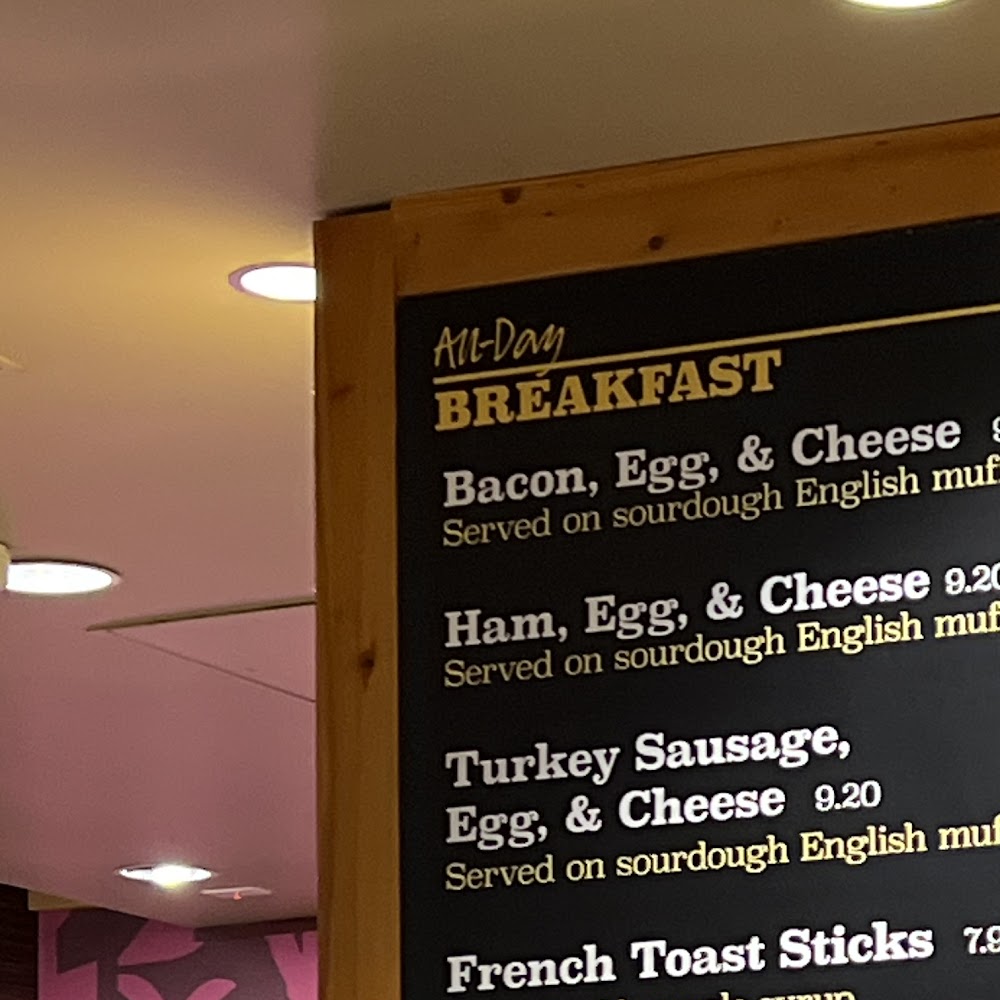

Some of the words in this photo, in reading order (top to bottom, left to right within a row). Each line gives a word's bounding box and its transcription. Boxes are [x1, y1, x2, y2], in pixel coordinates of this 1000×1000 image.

[433, 317, 565, 377] All-Day
[434, 350, 782, 432] BREAKFAST
[443, 467, 598, 507] Bacon,
[615, 449, 718, 494] Egg,
[737, 435, 774, 473] &
[792, 420, 961, 466] Cheese
[443, 508, 551, 546] Served
[563, 511, 601, 533] on
[613, 482, 784, 527] sourdough
[795, 465, 921, 509] English
[444, 609, 567, 647] Ham,
[584, 595, 688, 639] Egg,
[706, 582, 743, 620] &
[760, 570, 931, 614] Cheese
[445, 650, 553, 687] Served
[565, 653, 603, 675] on
[615, 625, 787, 670] sourdough
[796, 611, 924, 655] English
[445, 742, 621, 787] Turkey
[635, 726, 850, 771] Sausage,
[446, 805, 547, 850] Egg,
[565, 795, 602, 833] &
[619, 784, 785, 828] Cheese
[814, 780, 882, 812] 9.20
[446, 854, 556, 890] Served
[566, 858, 606, 881] on
[616, 834, 790, 876] sourdough
[799, 822, 928, 865] English
[447, 944, 617, 993] French
[630, 936, 766, 979] Toast
[779, 921, 934, 969] Sticks
